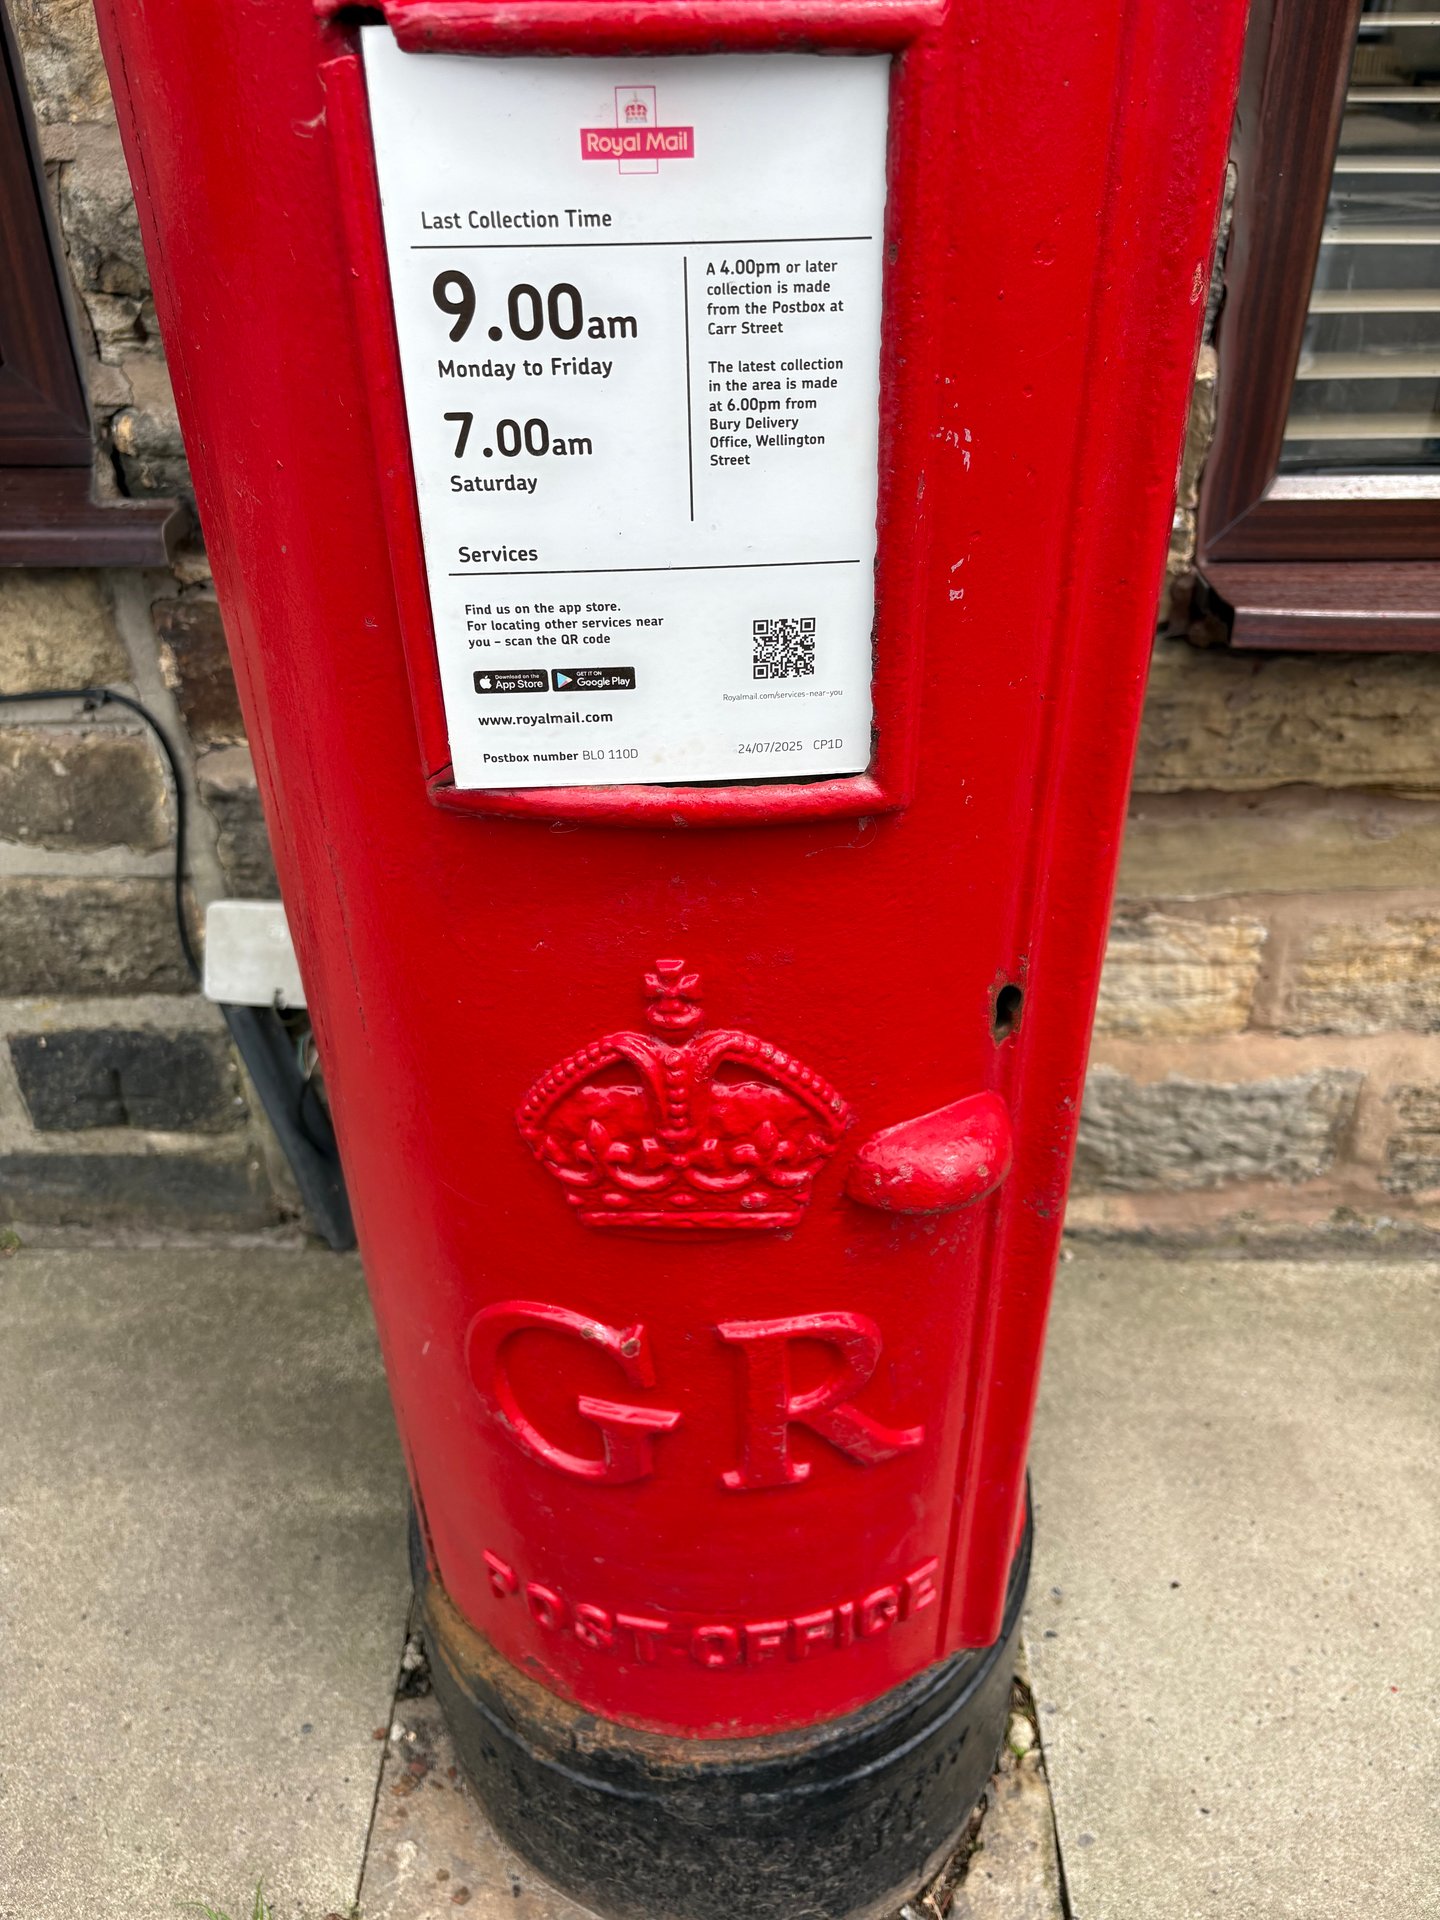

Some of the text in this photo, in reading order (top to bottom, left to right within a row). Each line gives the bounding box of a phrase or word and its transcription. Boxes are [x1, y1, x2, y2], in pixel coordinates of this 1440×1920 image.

[587, 132, 687, 156] Royal Mail
[421, 209, 611, 230] Last Collection Time
[705, 259, 839, 277] A 4.00pm or later
[706, 279, 831, 296] collection is made
[706, 299, 844, 316] from the Postbox at
[707, 321, 784, 336] Carr Street
[438, 357, 612, 381] Monday to Friday
[707, 357, 844, 374] The latest collection
[708, 376, 838, 393] in the area is made
[708, 397, 817, 414] at 6.00pm from
[709, 416, 799, 433] Bury Delivery
[709, 433, 825, 449] Office, Wellington
[710, 454, 751, 467] Street
[451, 474, 537, 494] Saturday
[458, 545, 539, 563] Services
[464, 602, 621, 616] Find us on the app store.
[466, 616, 664, 633] For locating other services near
[468, 638, 491, 650] you
[504, 637, 533, 647] scan
[536, 634, 557, 646] the
[561, 633, 579, 645] QR
[582, 633, 611, 645] code
[496, 680, 543, 690] App Store
[577, 677, 630, 688] Google Play
[722, 690, 844, 703] Royalmail.com/services-near-you
[477, 711, 613, 727] www.royalmail.com
[737, 738, 843, 754] 24/07/2025 CP1D
[483, 752, 530, 764] Postbox
[532, 751, 579, 762] number
[482, 1549, 940, 1668] POST OFFICE
